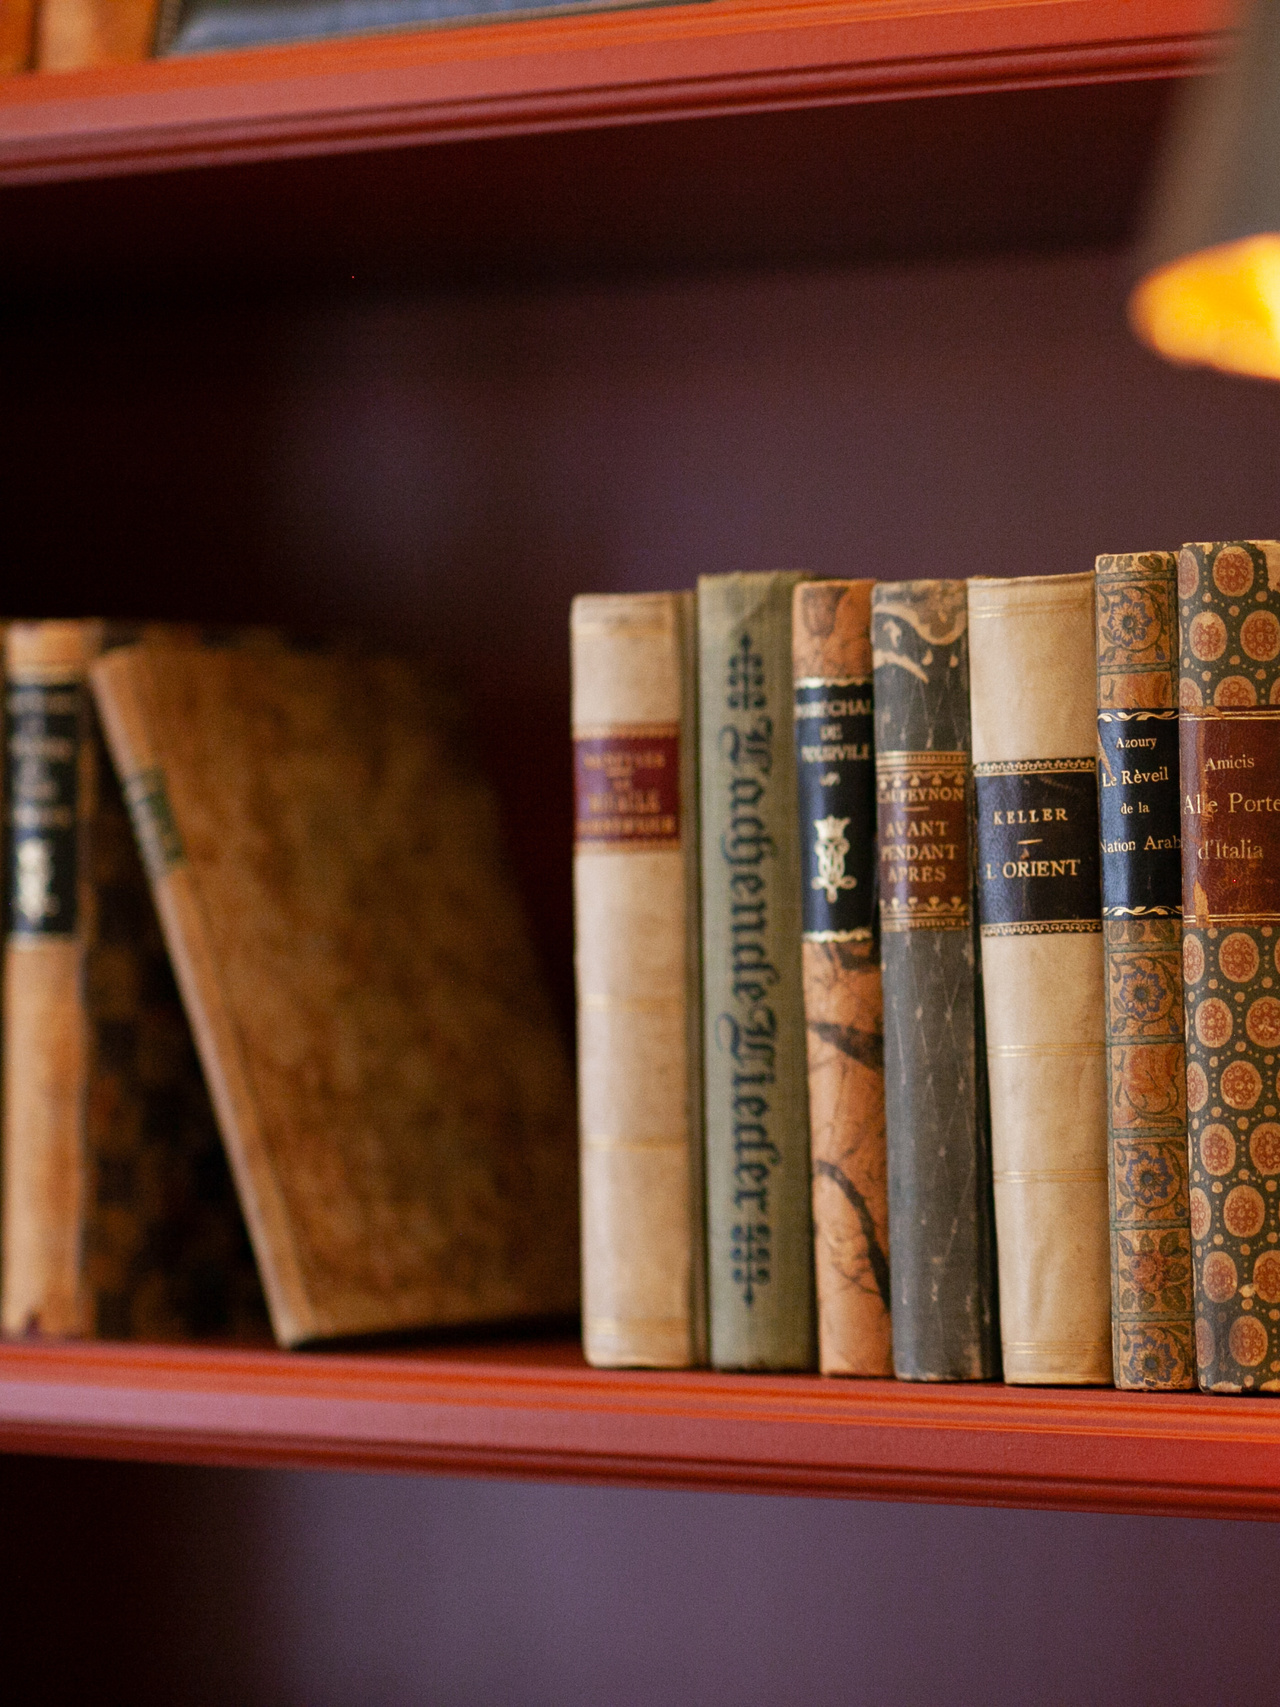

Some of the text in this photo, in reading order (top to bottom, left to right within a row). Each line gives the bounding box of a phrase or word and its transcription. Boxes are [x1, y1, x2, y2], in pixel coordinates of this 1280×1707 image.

[1116, 736, 1157, 750] Azoury
[1203, 754, 1255, 773] Amicis
[1102, 772, 1117, 788] Le
[1120, 802, 1150, 815] de la
[1183, 794, 1219, 815] Alle
[992, 807, 1069, 826] KELLER
[884, 820, 949, 839] AVANT
[1101, 838, 1136, 855] Nation
[715, 1005, 782, 1213] Lieder
